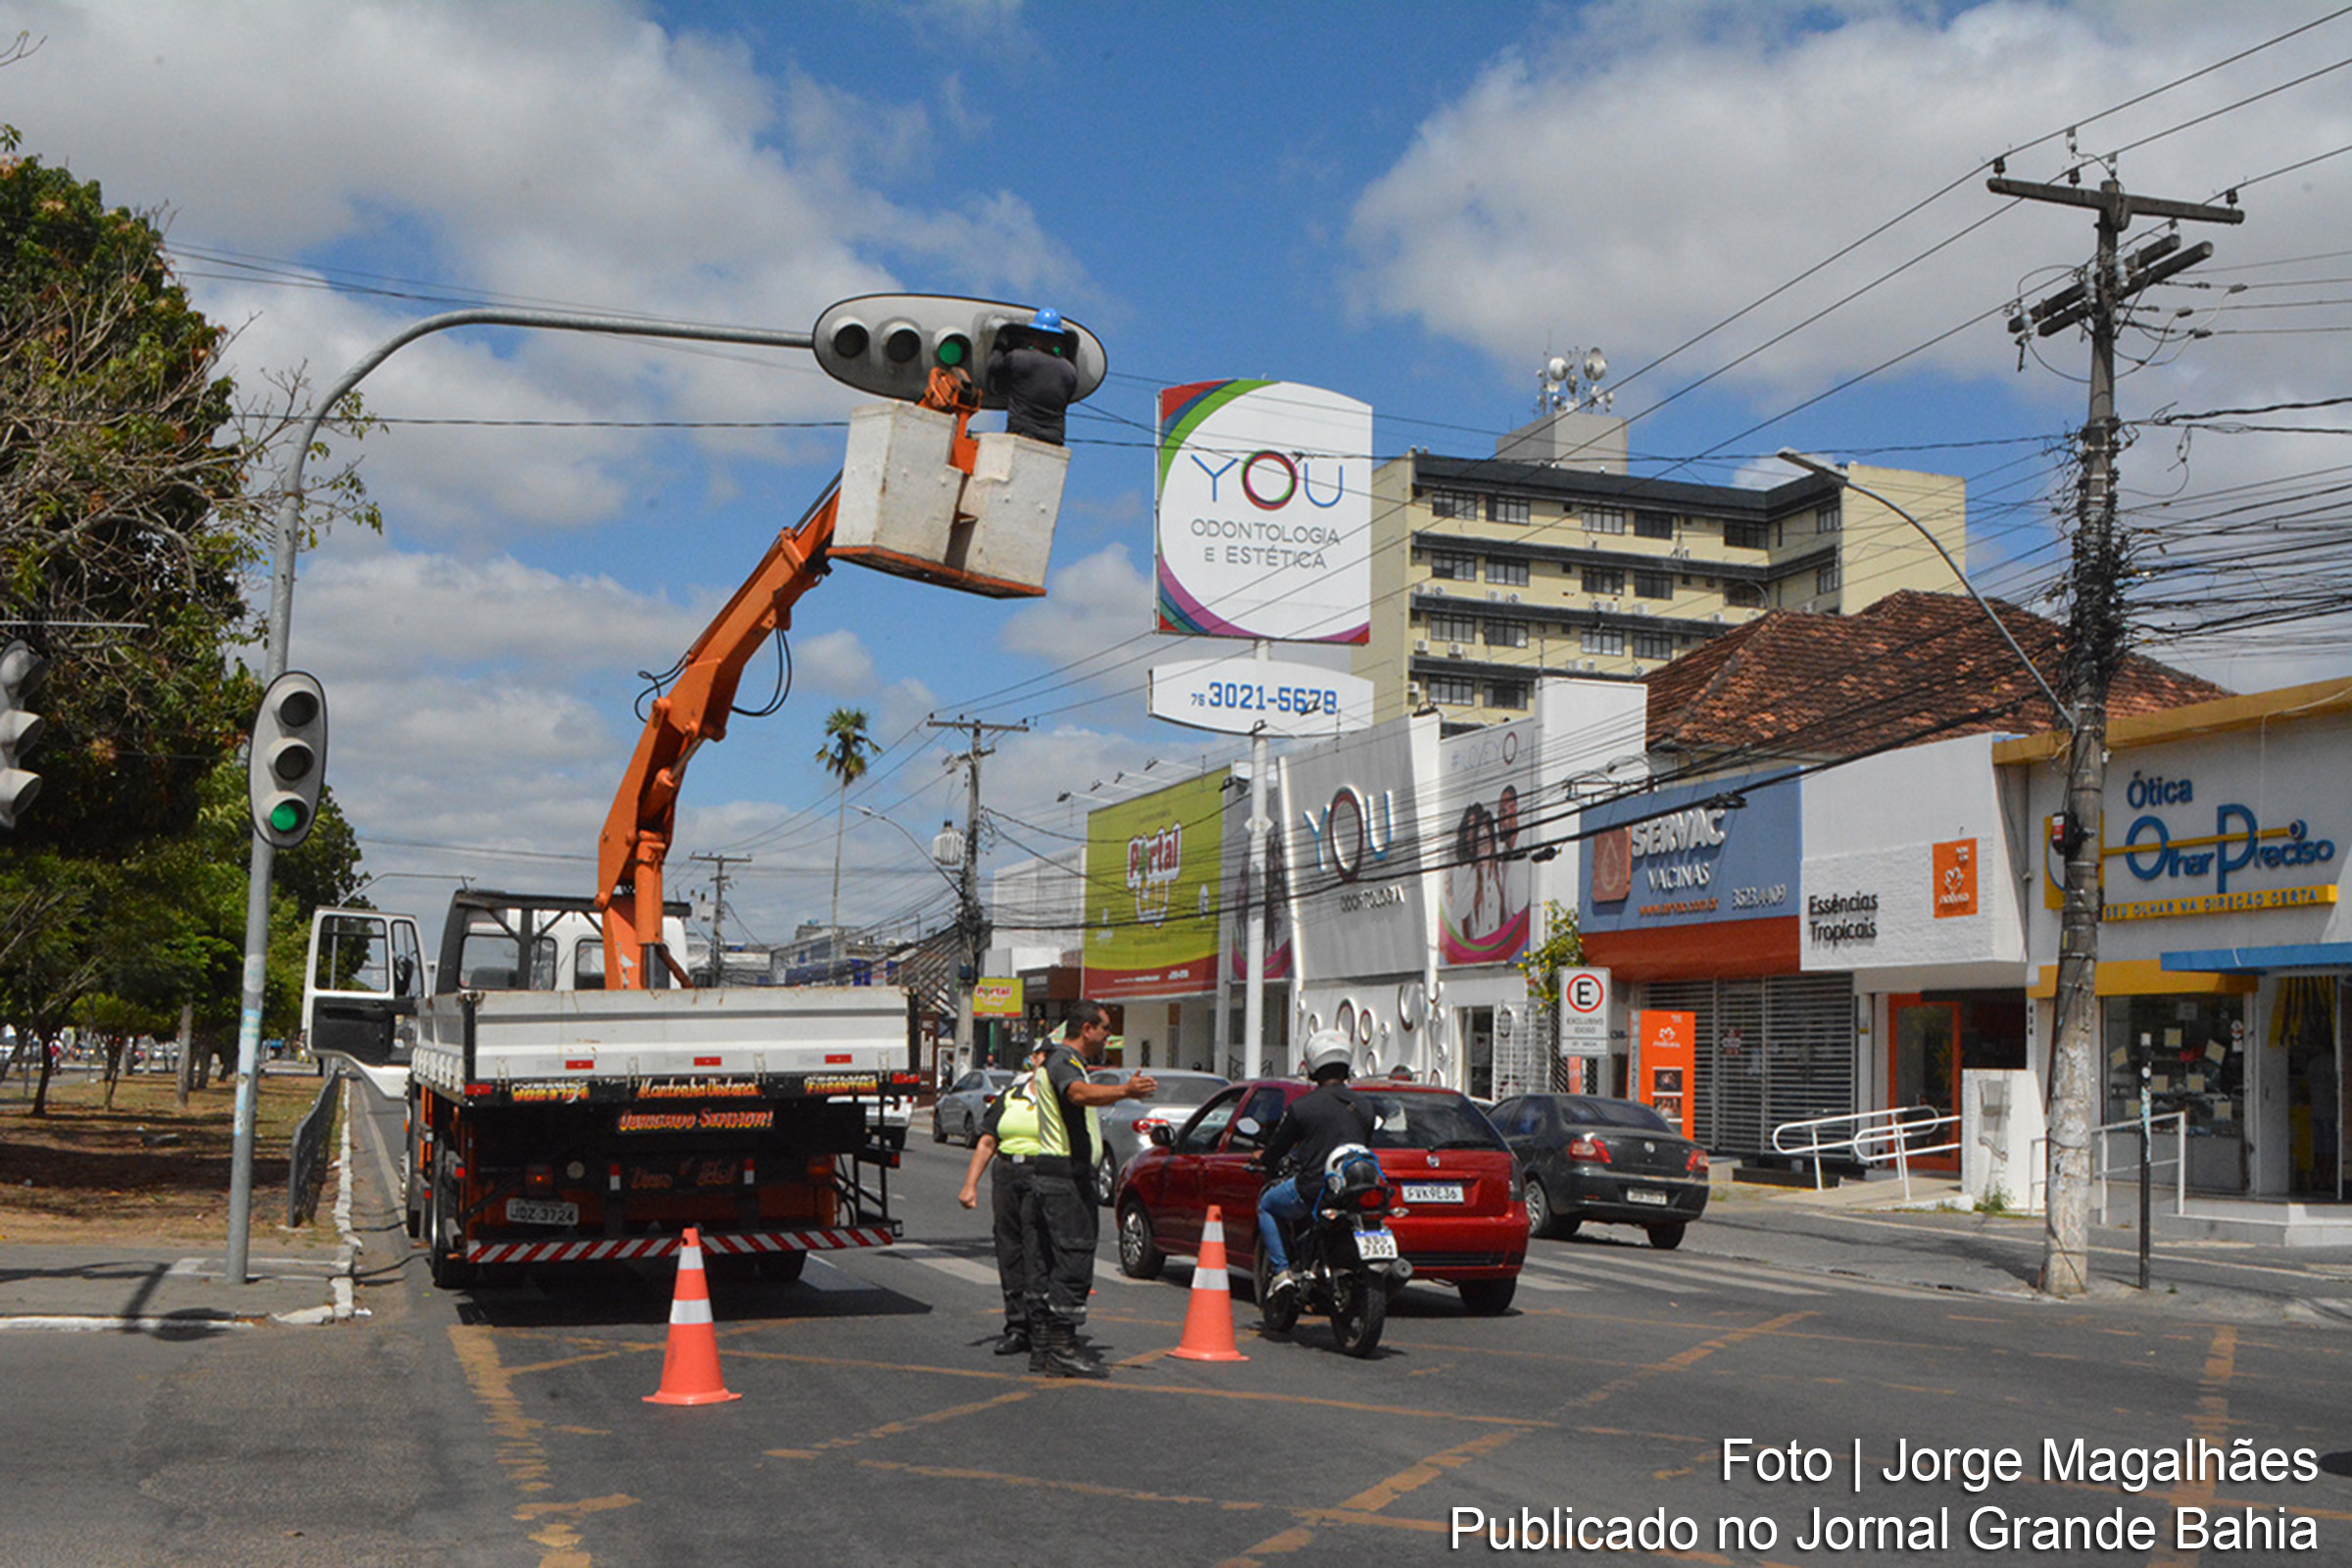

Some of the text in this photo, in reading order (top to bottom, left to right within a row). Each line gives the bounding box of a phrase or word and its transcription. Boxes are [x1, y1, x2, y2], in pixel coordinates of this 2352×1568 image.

[1191, 450, 1344, 511] YOU
[1191, 518, 1341, 545] ODONTOLOGIA
[1204, 544, 1327, 568] E ESTÉTICA
[1208, 682, 1339, 714] 3021-5678
[2127, 770, 2193, 809] Ótica
[1303, 786, 1393, 882] YOU
[1631, 811, 1726, 857] SERVAC
[2126, 804, 2335, 894] Olhar Preciso
[1647, 862, 1711, 891] VACINAS
[1808, 891, 1879, 916] Essências
[2107, 888, 2308, 918] SEU OLHAR NA DIREÇÃO CERTA
[1809, 918, 1878, 945] Tropicais
[1578, 981, 1592, 1005] E
[618, 1106, 774, 1131] OBRIGADO SENHOR!
